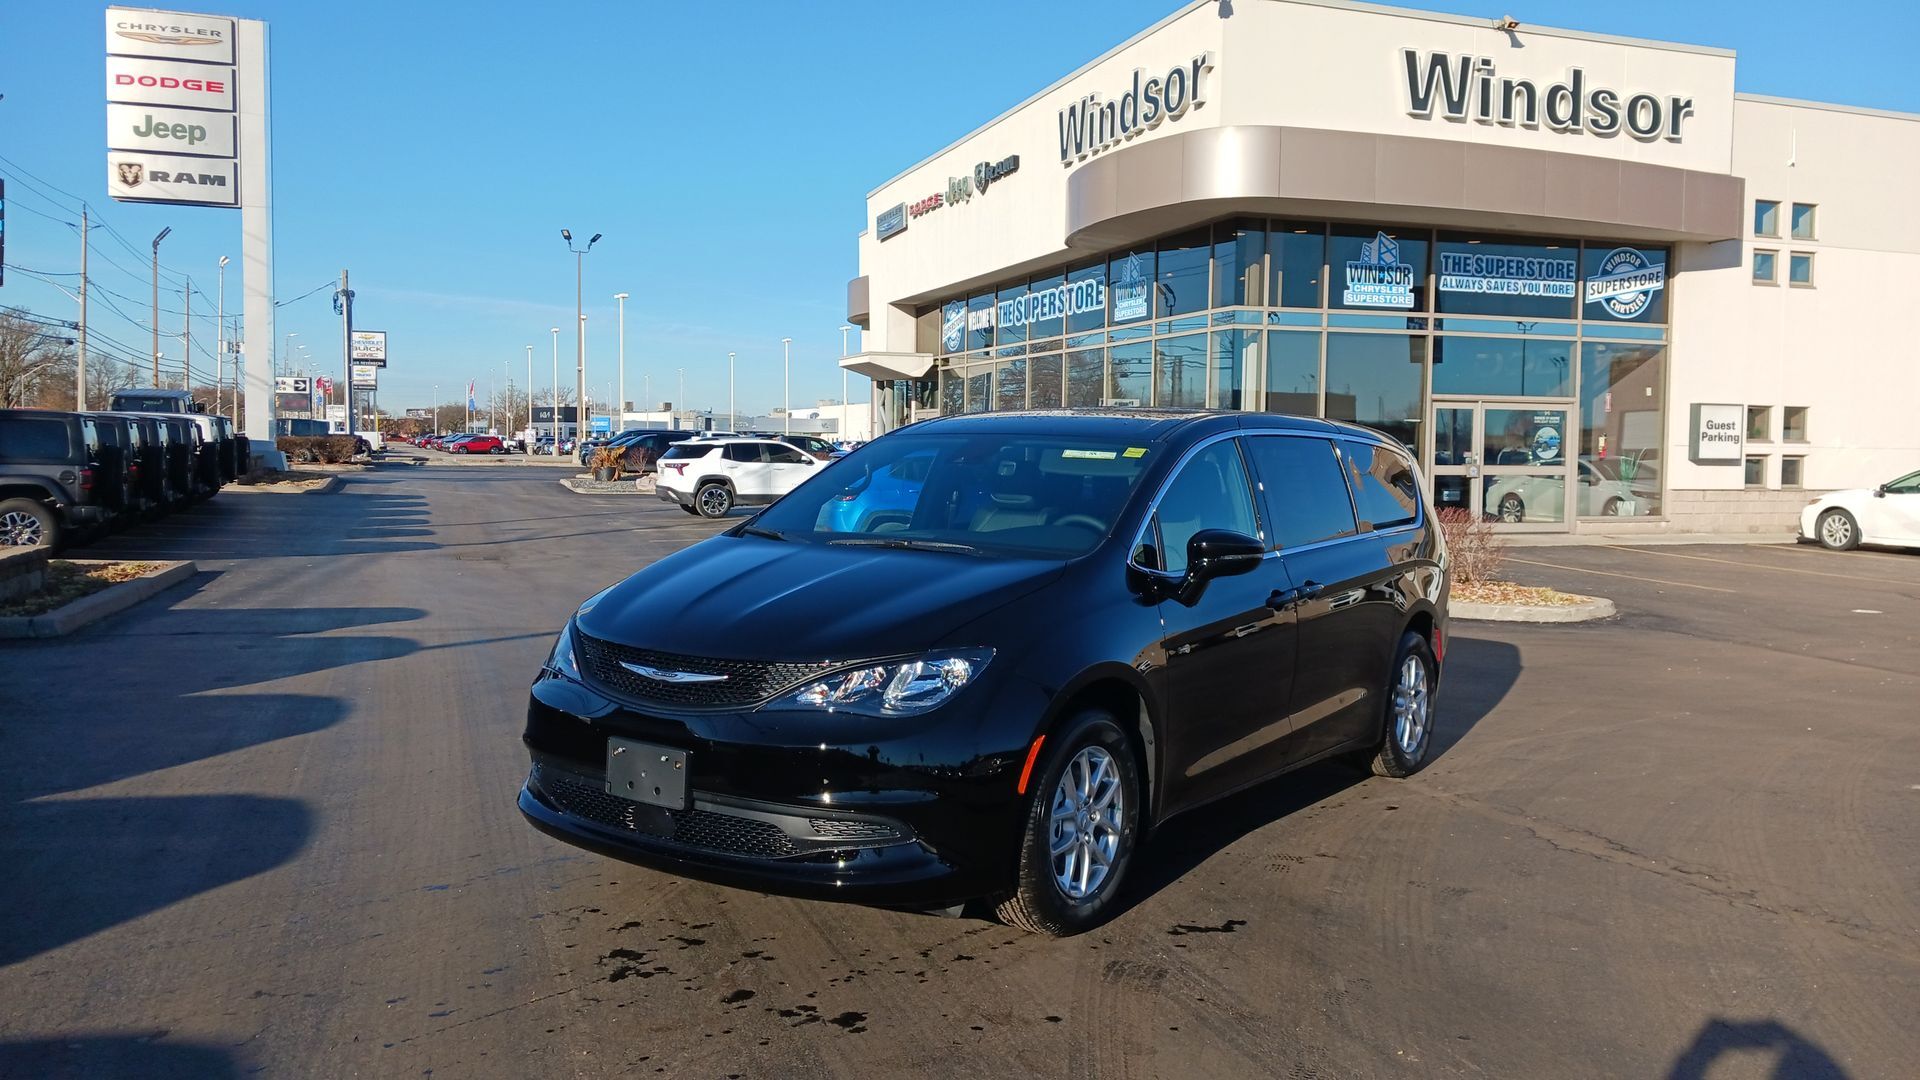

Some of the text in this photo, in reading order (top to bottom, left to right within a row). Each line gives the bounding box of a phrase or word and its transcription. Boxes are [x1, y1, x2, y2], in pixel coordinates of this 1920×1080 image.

[117, 22, 222, 37] CHRYSLER
[116, 74, 224, 93] DODGE
[1402, 48, 1694, 138] Windsor
[1058, 50, 1214, 164] Windsor
[133, 115, 206, 145] Jeep
[986, 155, 1018, 180] RAM
[149, 170, 226, 187] RAM
[945, 177, 972, 203] Jeep
[909, 193, 943, 216] DODGE
[1442, 255, 1575, 279] THE SUPERSTORE
[1605, 252, 1642, 272] WINDSOR
[1348, 263, 1411, 285] WINDSOR
[1590, 271, 1662, 296] SUPERSTORE
[1353, 284, 1405, 294] CHRYSLER
[1442, 278, 1575, 295] ALWAYS SAVES YOU MORE!
[998, 303, 1013, 326] THE
[1014, 278, 1105, 325] SUPERSTORE
[1346, 293, 1412, 304] SUPERSTORE
[1610, 293, 1647, 313] CHRYSLER
[1705, 420, 1736, 430] Guest
[1701, 432, 1740, 444] Parking
